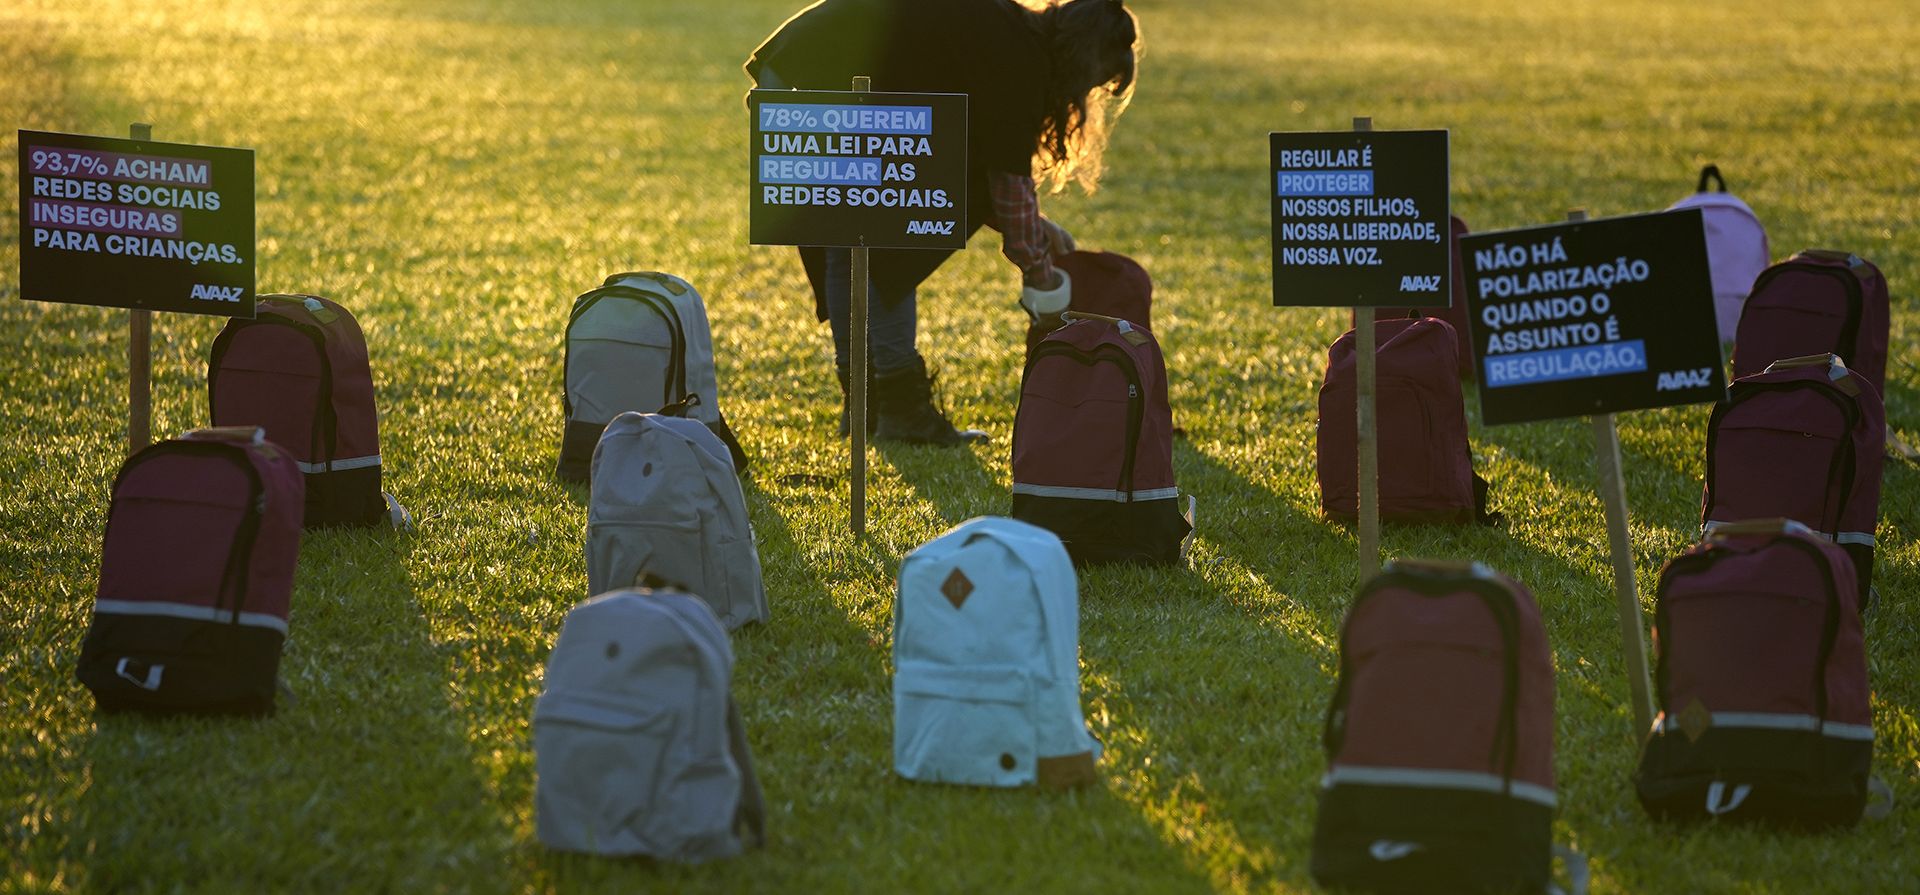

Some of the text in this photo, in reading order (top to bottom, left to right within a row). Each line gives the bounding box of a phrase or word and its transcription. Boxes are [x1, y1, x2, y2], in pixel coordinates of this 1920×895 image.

[763, 108, 926, 132] 78% QUEREM
[763, 134, 932, 156] UMA LEI PARA
[1281, 145, 1372, 167] REGULAR É
[32, 150, 207, 183] 93,7% ACHAM
[763, 160, 916, 182] REGULAR AS
[34, 177, 220, 210] REDES SOCIAIS
[1282, 174, 1369, 192] PROTEGER
[763, 186, 953, 208] REDES SOCIAIS.
[34, 202, 177, 232] INSEGURAS
[1282, 198, 1419, 219] NOSSOS FILHOS,
[907, 221, 955, 234] AVAAZ
[1282, 222, 1440, 243] NOSSA LIBERDADE,
[34, 229, 243, 265] PARA CRIANÇAS.
[1283, 247, 1382, 265] NOSSA VOZ.
[1475, 237, 1567, 272] NÃO HÁ
[1400, 276, 1440, 291] AVAAZ
[1479, 257, 1649, 299] POLARIZAÇÃO
[191, 284, 243, 301] AVAAZ
[1483, 293, 1610, 329] QUANDO O
[1487, 316, 1620, 354] ASSUNTO É
[1491, 345, 1643, 381] REGULAÇÃO.
[1657, 368, 1712, 391] AVAAZ
